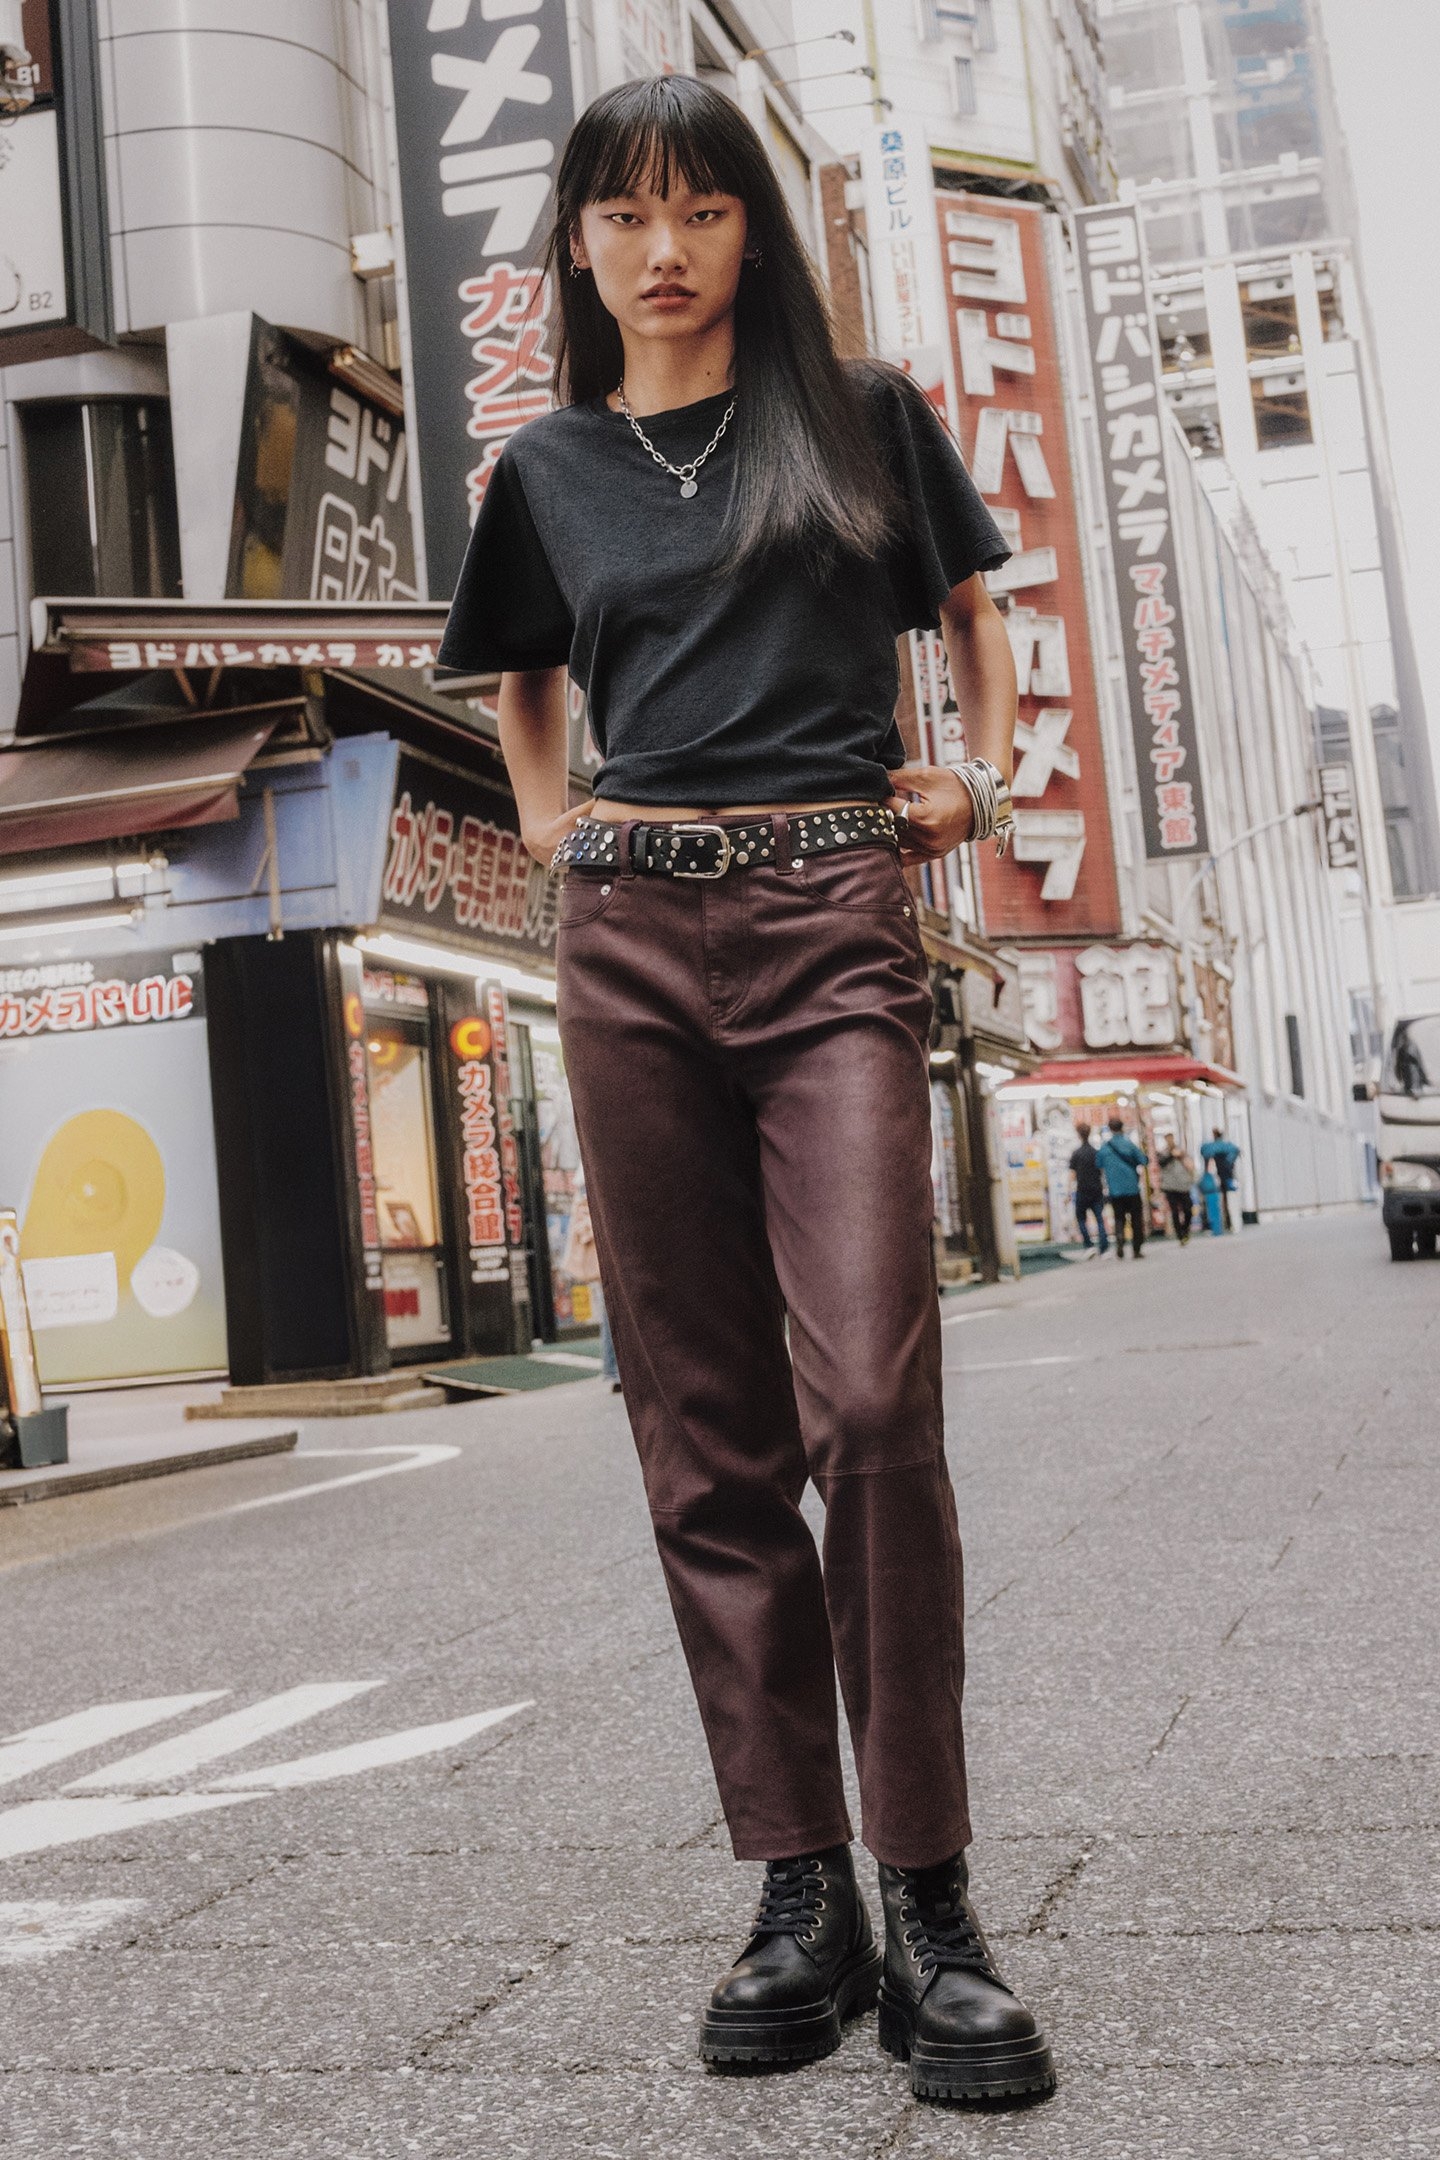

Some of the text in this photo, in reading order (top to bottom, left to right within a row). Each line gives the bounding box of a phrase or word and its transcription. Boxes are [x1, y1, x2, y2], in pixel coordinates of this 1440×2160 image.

[28, 291, 52, 312] B2
[1084, 216, 1169, 557] ヨドバシカメラ
[108, 642, 357, 669] ヨドバシカメラ
